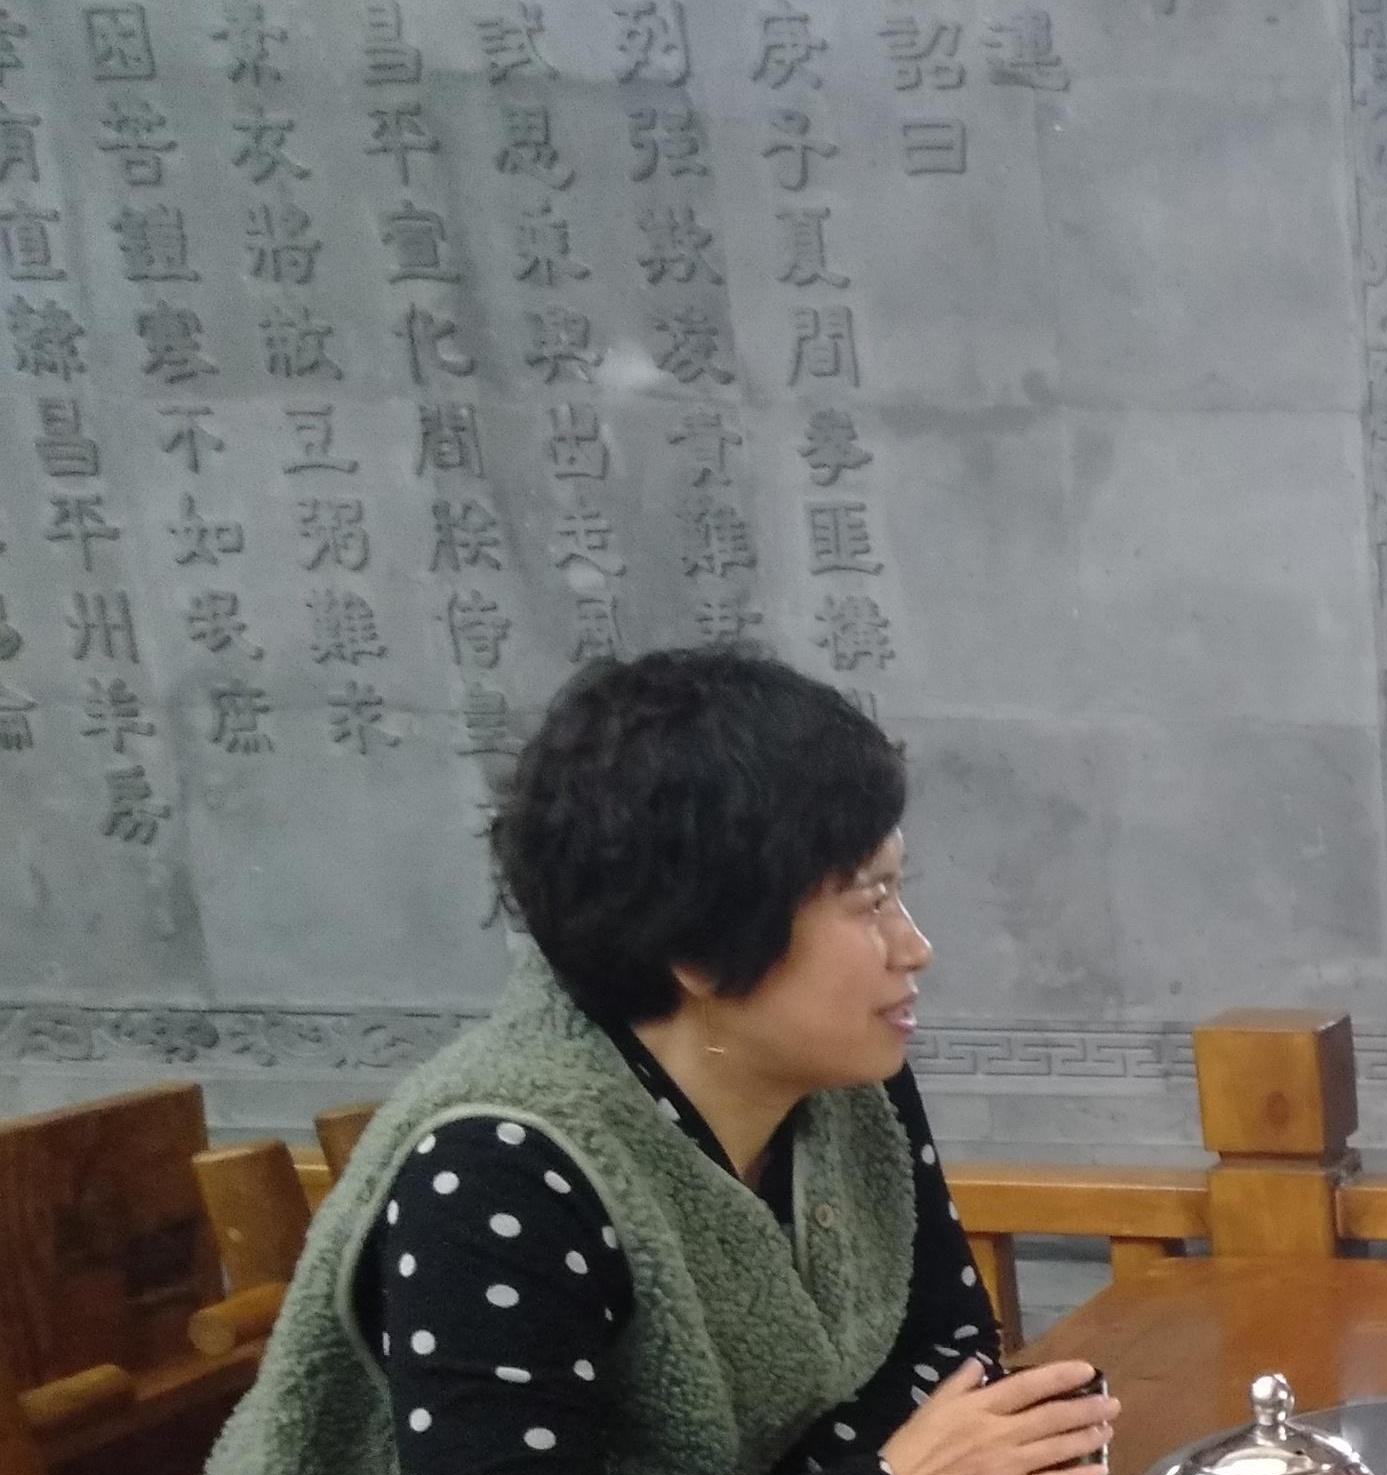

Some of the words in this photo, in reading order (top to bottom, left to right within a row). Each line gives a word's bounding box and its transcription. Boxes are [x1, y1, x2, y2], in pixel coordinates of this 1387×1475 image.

[363, 0, 523, 838] 昌平宣化間朕侍皇
